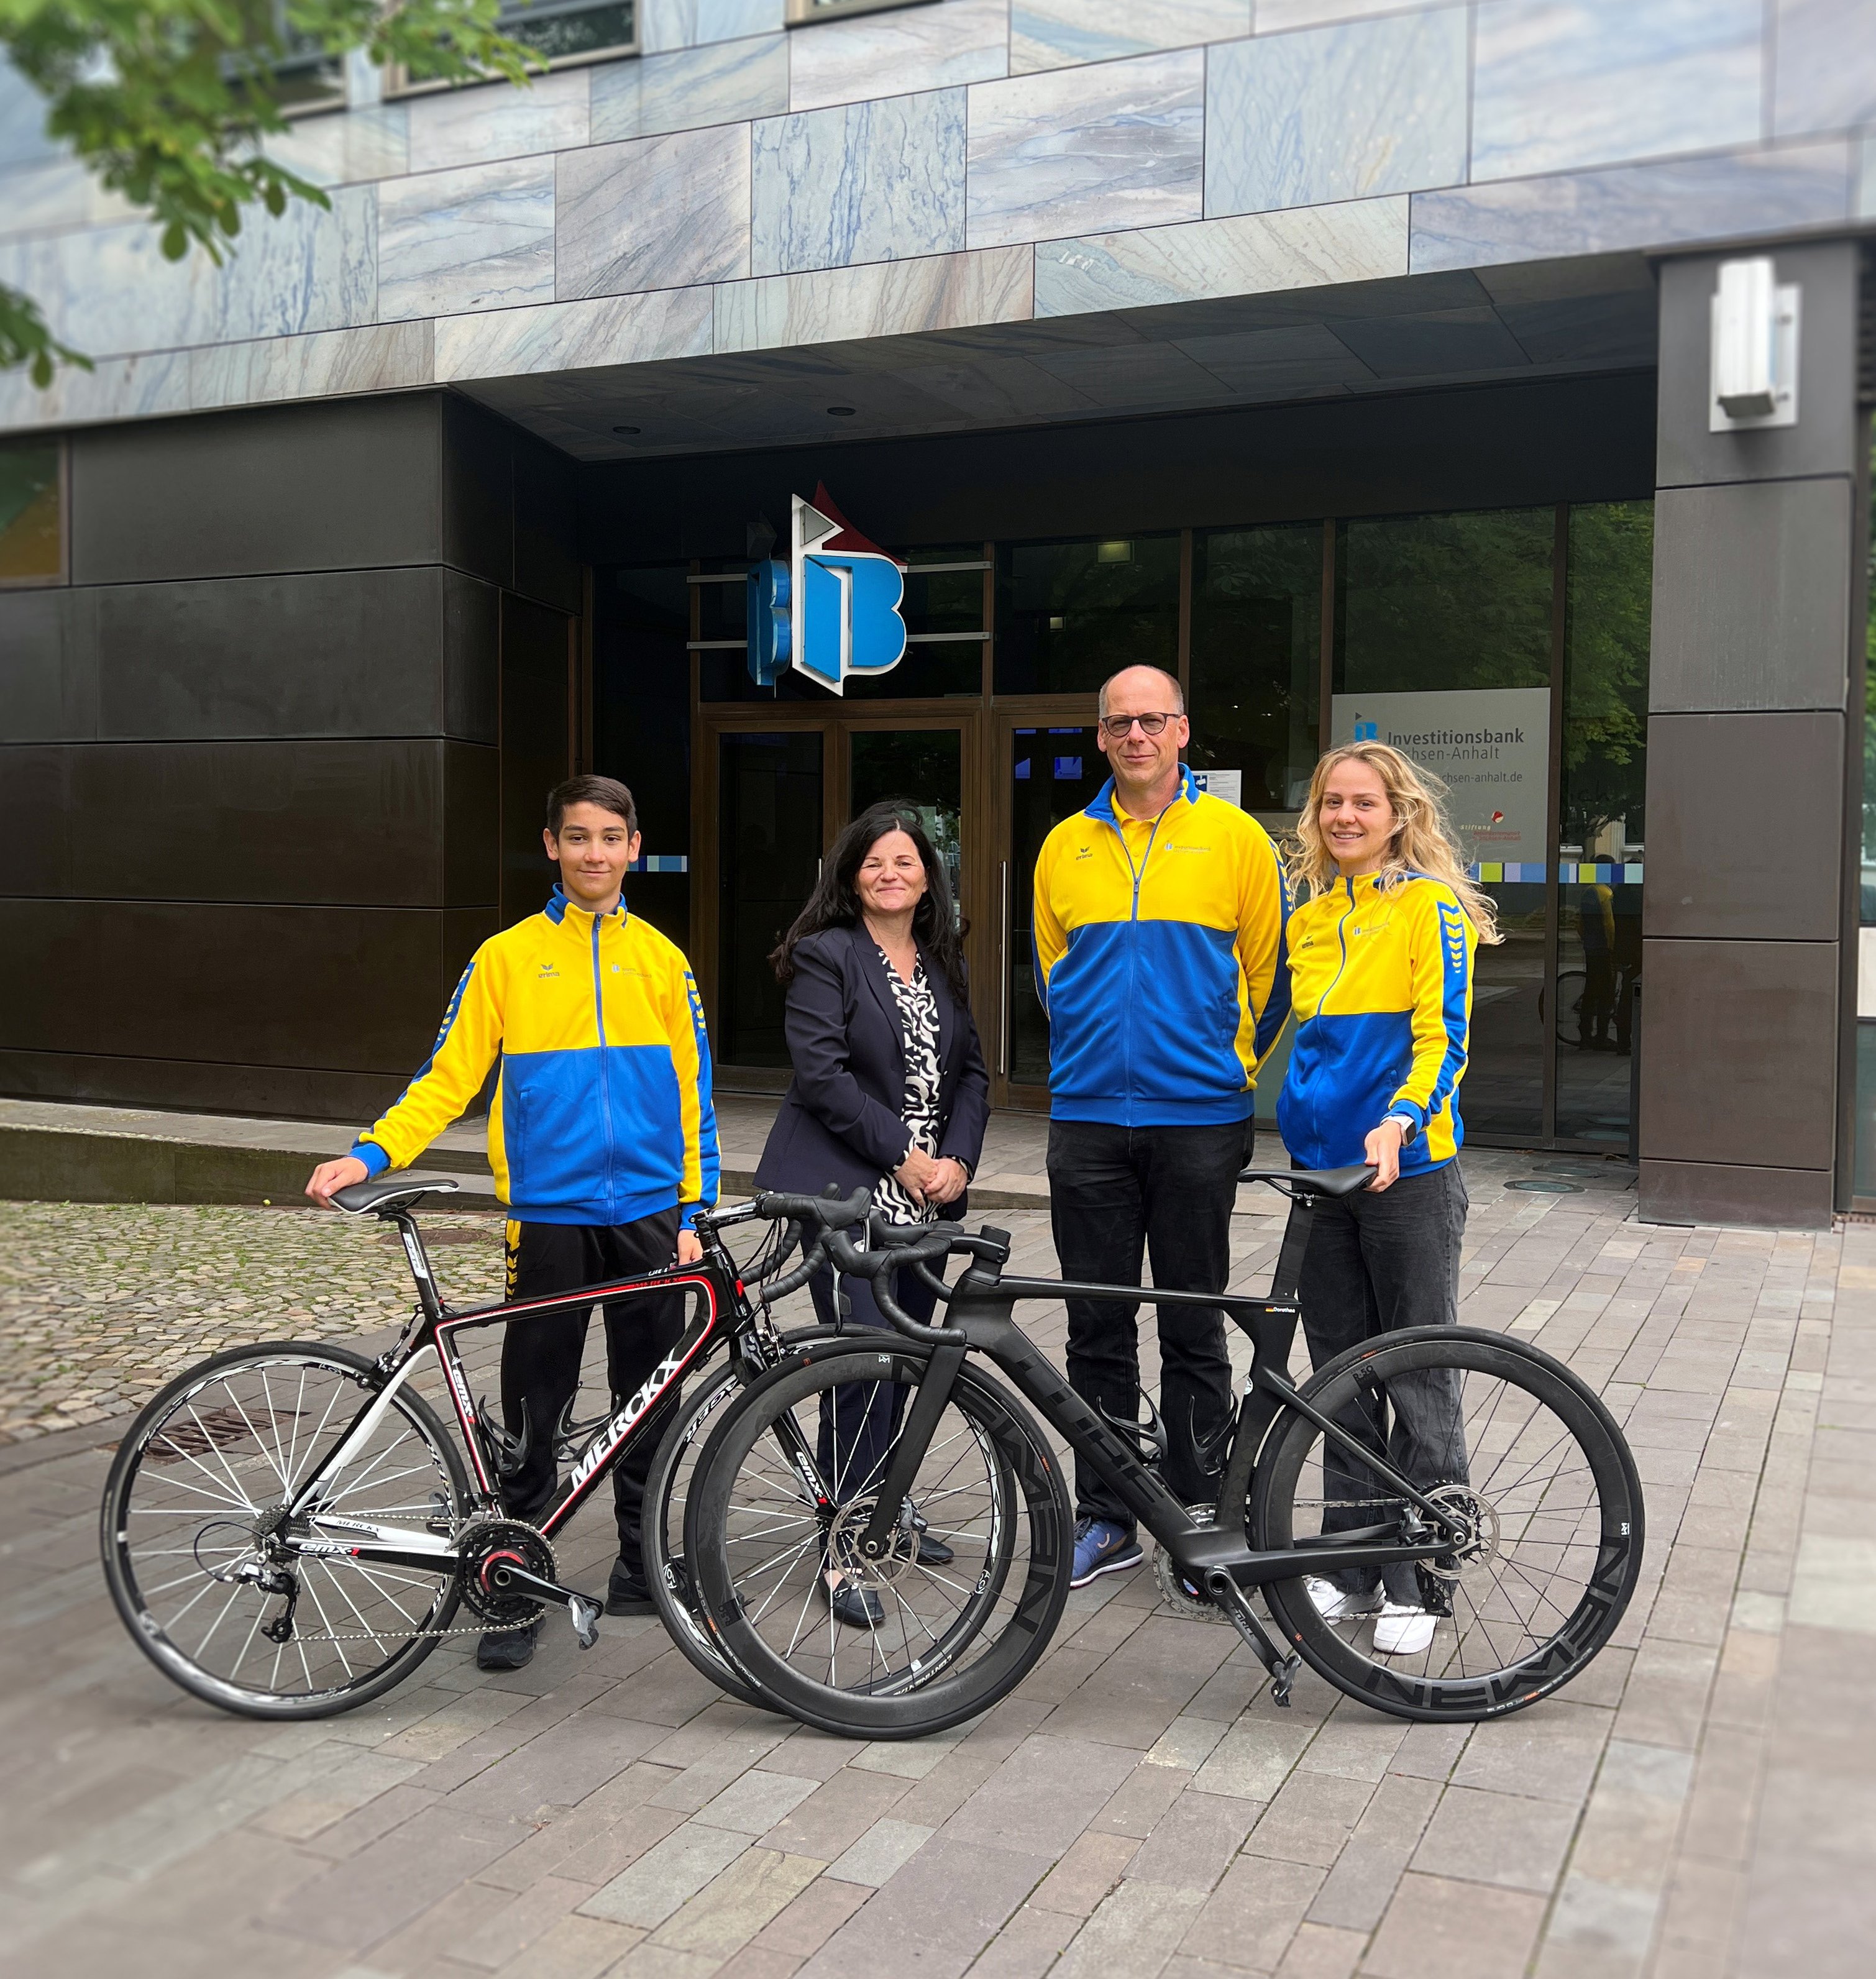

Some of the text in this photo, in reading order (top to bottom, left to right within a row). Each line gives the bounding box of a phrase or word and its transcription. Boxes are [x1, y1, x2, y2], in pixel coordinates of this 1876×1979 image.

[1388, 728, 1524, 746] Investitionsbank
[1404, 745, 1499, 761] chsen-Anhalt
[1442, 771, 1523, 784] chsen-anhalt.de
[570, 1347, 682, 1491] MERCKX
[336, 1520, 382, 1533] MERCKX
